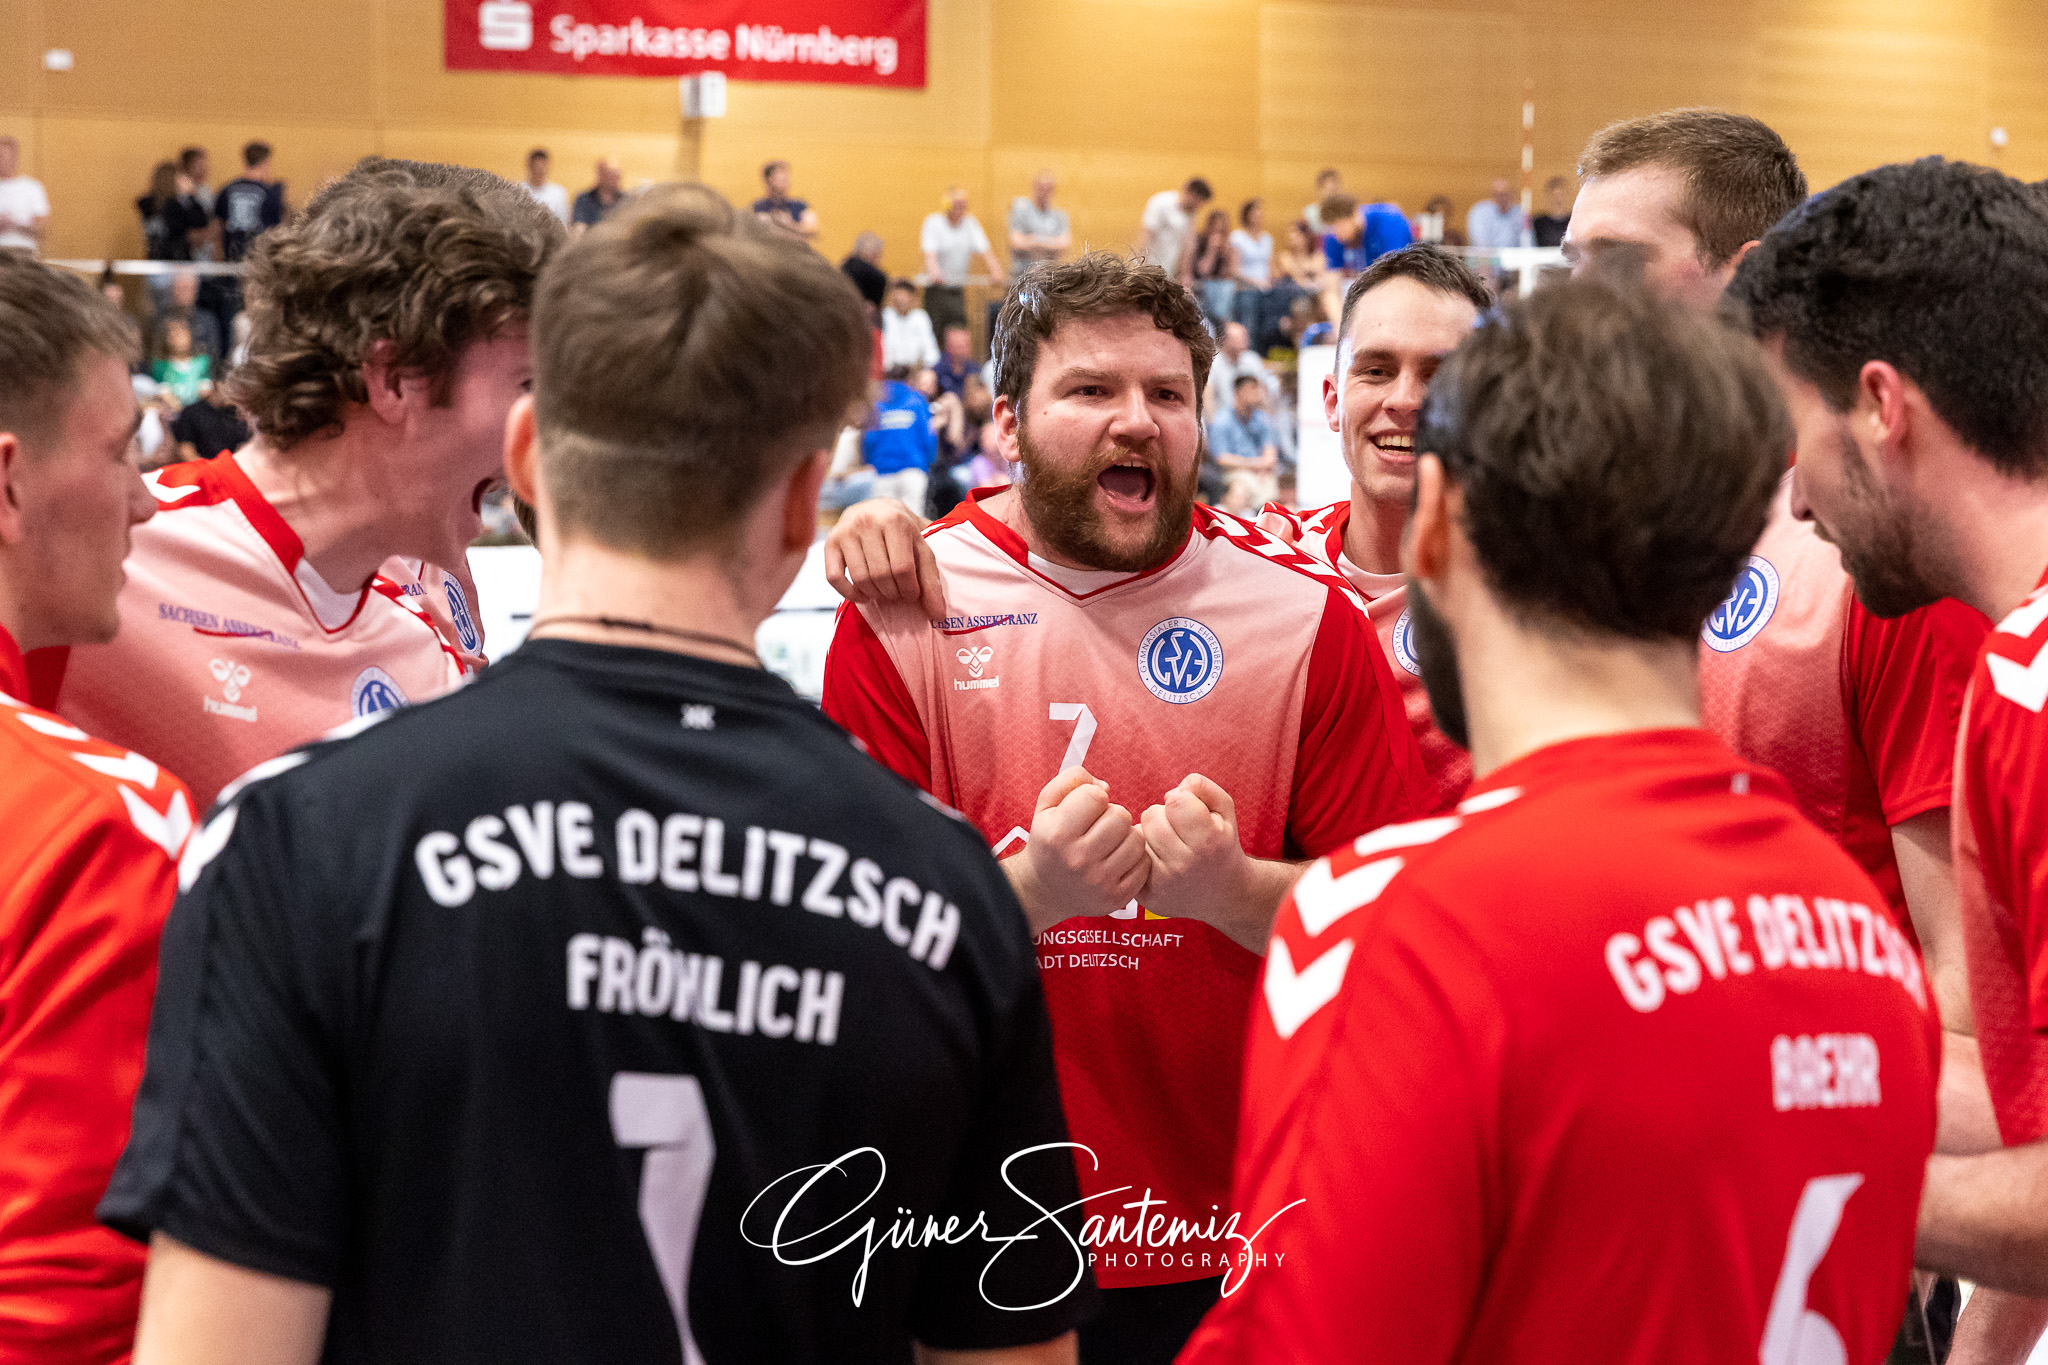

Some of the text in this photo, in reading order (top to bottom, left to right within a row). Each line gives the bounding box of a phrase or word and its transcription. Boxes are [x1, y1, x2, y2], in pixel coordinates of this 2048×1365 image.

[549, 14, 731, 61] Sparkasse
[735, 23, 899, 75] Nürnberg
[967, 612, 1038, 628] ASSEKURANZ
[1139, 619, 1221, 680] GYMNASIALER SV EHRENBERG
[1394, 611, 1412, 653] GYMNAS
[953, 675, 999, 691] hummel
[1150, 684, 1204, 702] DELITZSCH
[1049, 702, 1098, 775] 7
[414, 801, 962, 972] GSVE DELITZSCH
[1069, 953, 1139, 970] DELITZSCH
[1604, 895, 1755, 1014] GSVE
[565, 926, 846, 1047] FRÖHLICH
[1769, 1032, 1882, 1112] BAEHR
[1758, 1172, 1866, 1365] 6
